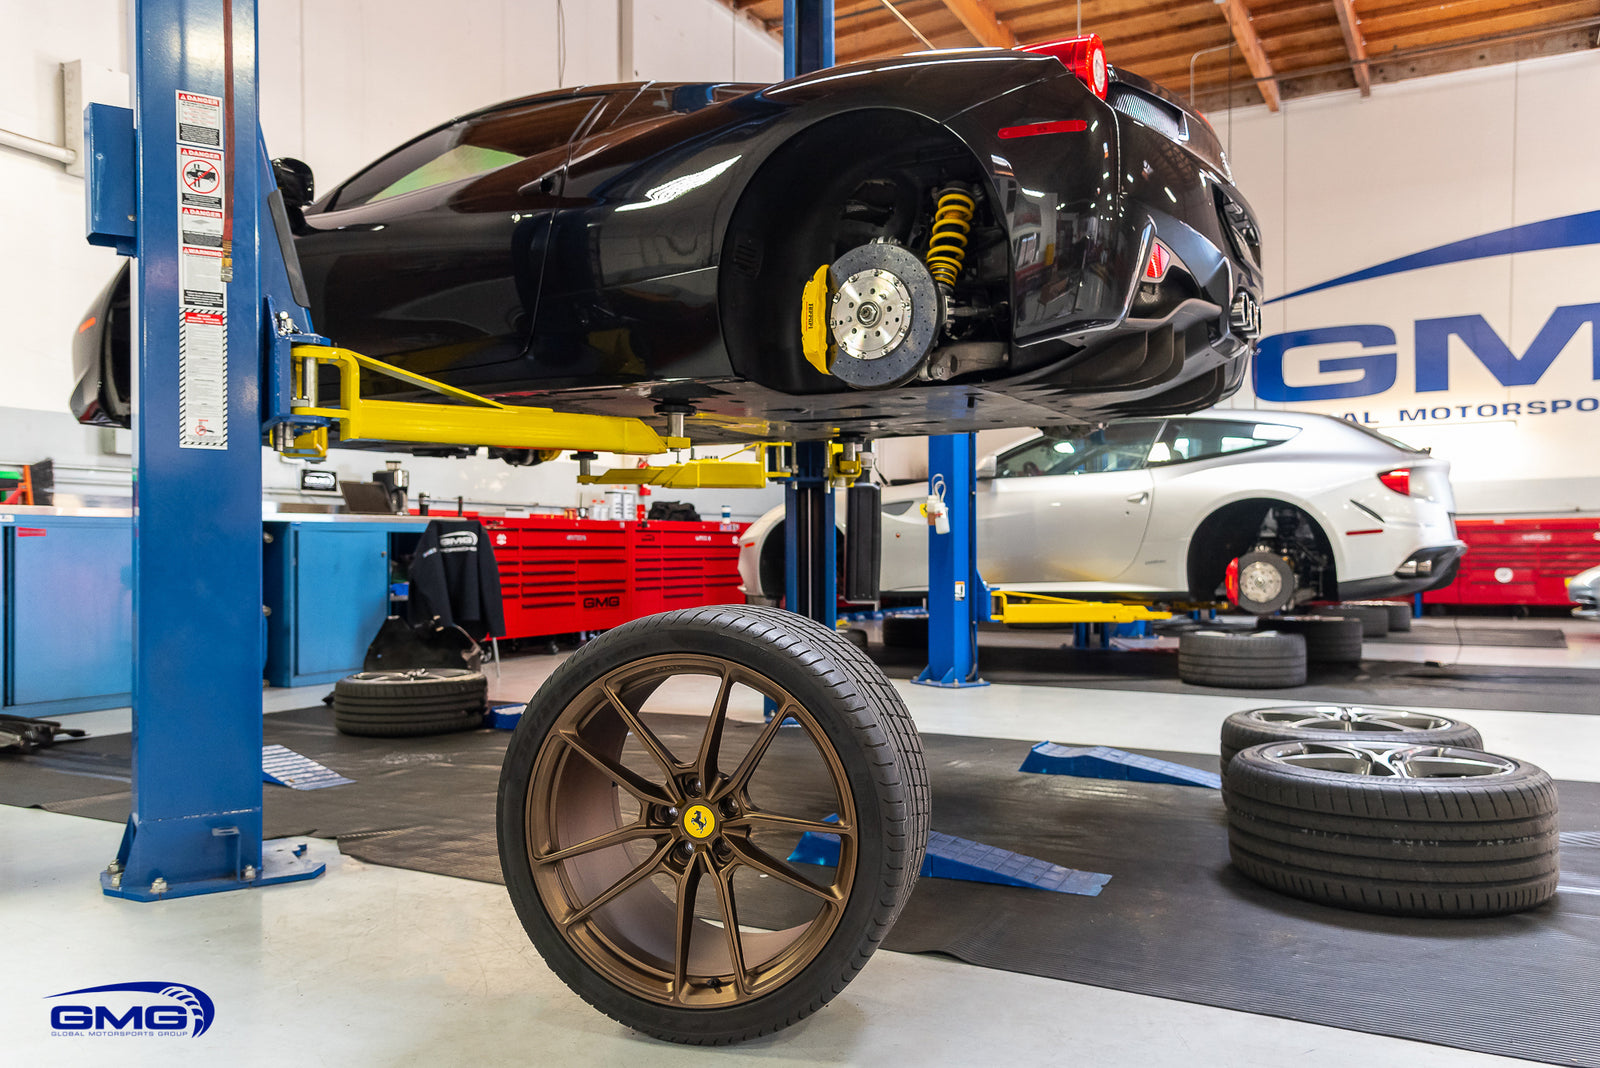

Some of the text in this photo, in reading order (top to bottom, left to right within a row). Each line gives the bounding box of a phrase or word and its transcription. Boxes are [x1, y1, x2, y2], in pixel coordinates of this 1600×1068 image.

[187, 94, 219, 106] DANGER
[188, 149, 221, 159] DANGER
[190, 208, 221, 218] DANGER
[188, 248, 222, 257] WARNING
[1399, 397, 1600, 422] MOTORSPO
[583, 596, 620, 609] GMG
